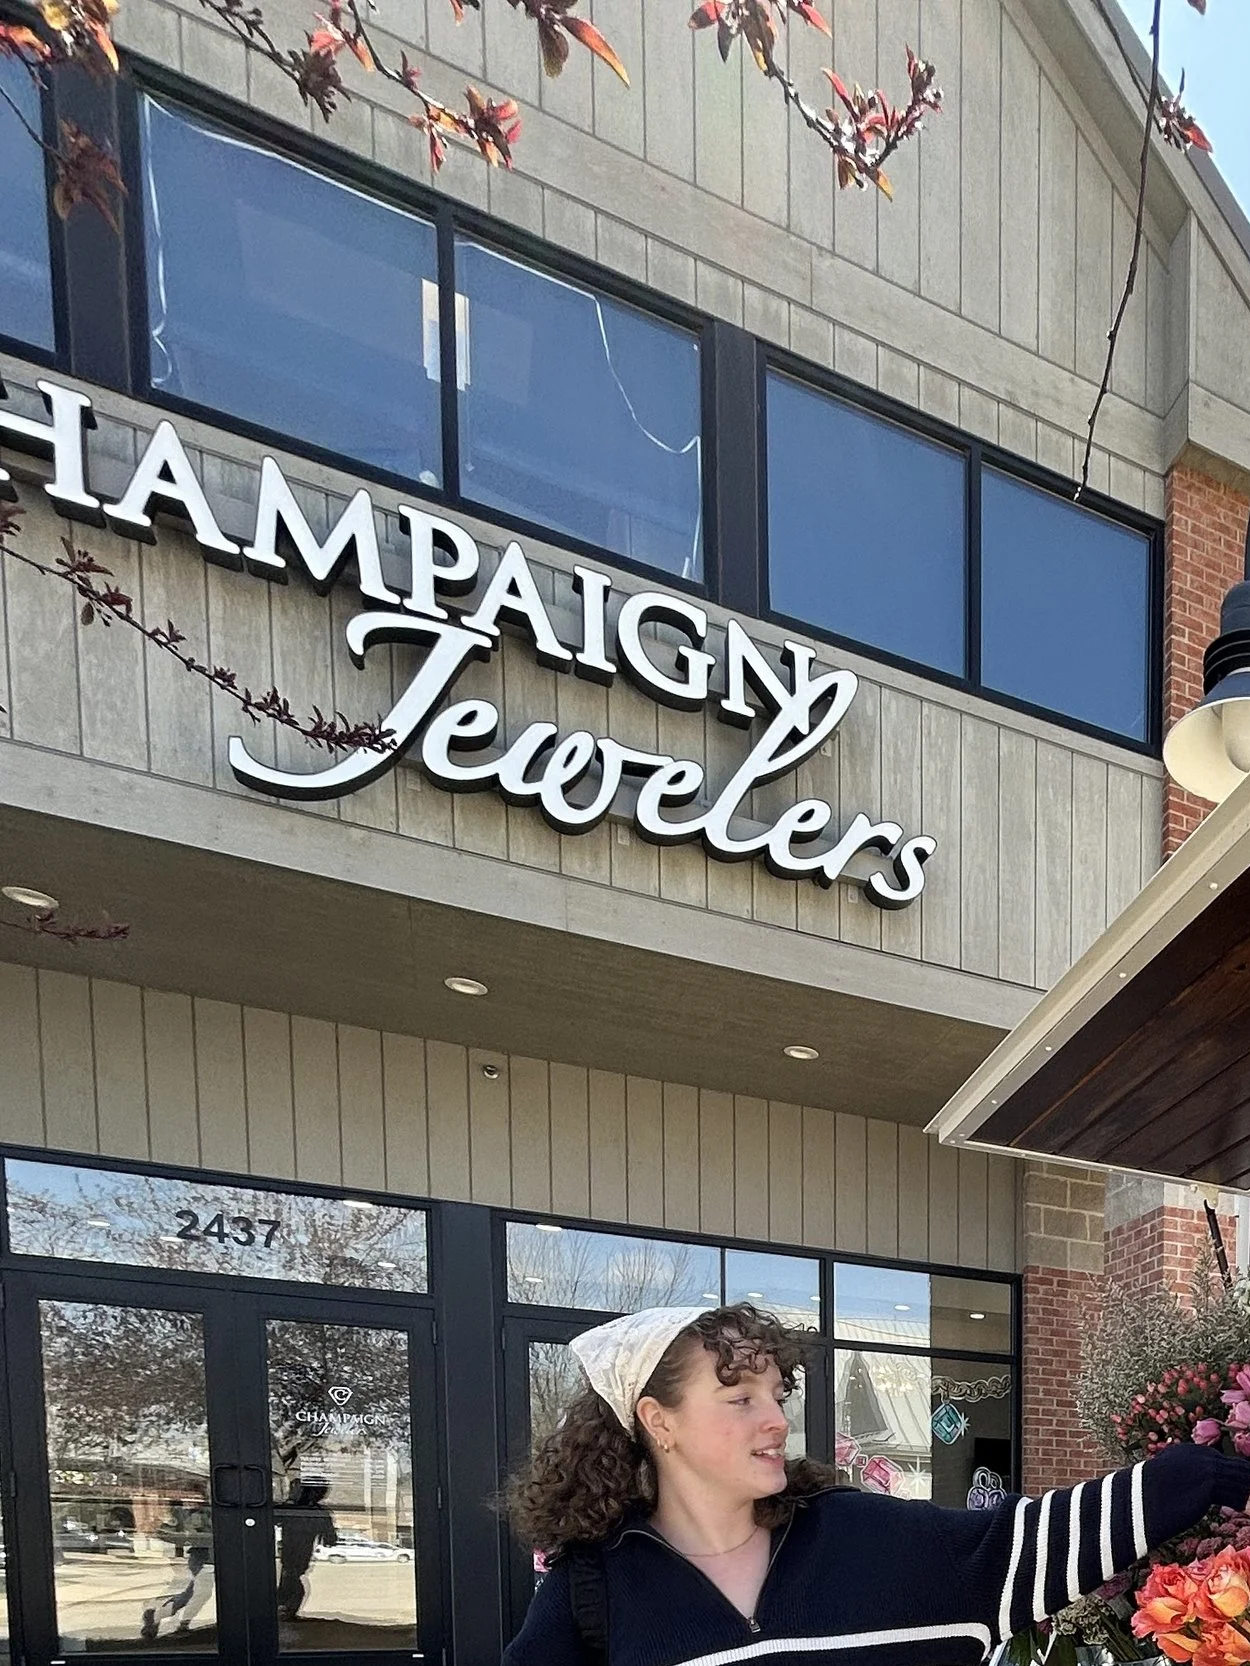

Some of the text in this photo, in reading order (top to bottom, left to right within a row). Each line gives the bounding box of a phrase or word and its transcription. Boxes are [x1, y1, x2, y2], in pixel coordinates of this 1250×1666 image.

[228, 612, 938, 908] Jewelers
[175, 1209, 281, 1248] 2437
[295, 1410, 386, 1425] CHAMPAIGN
